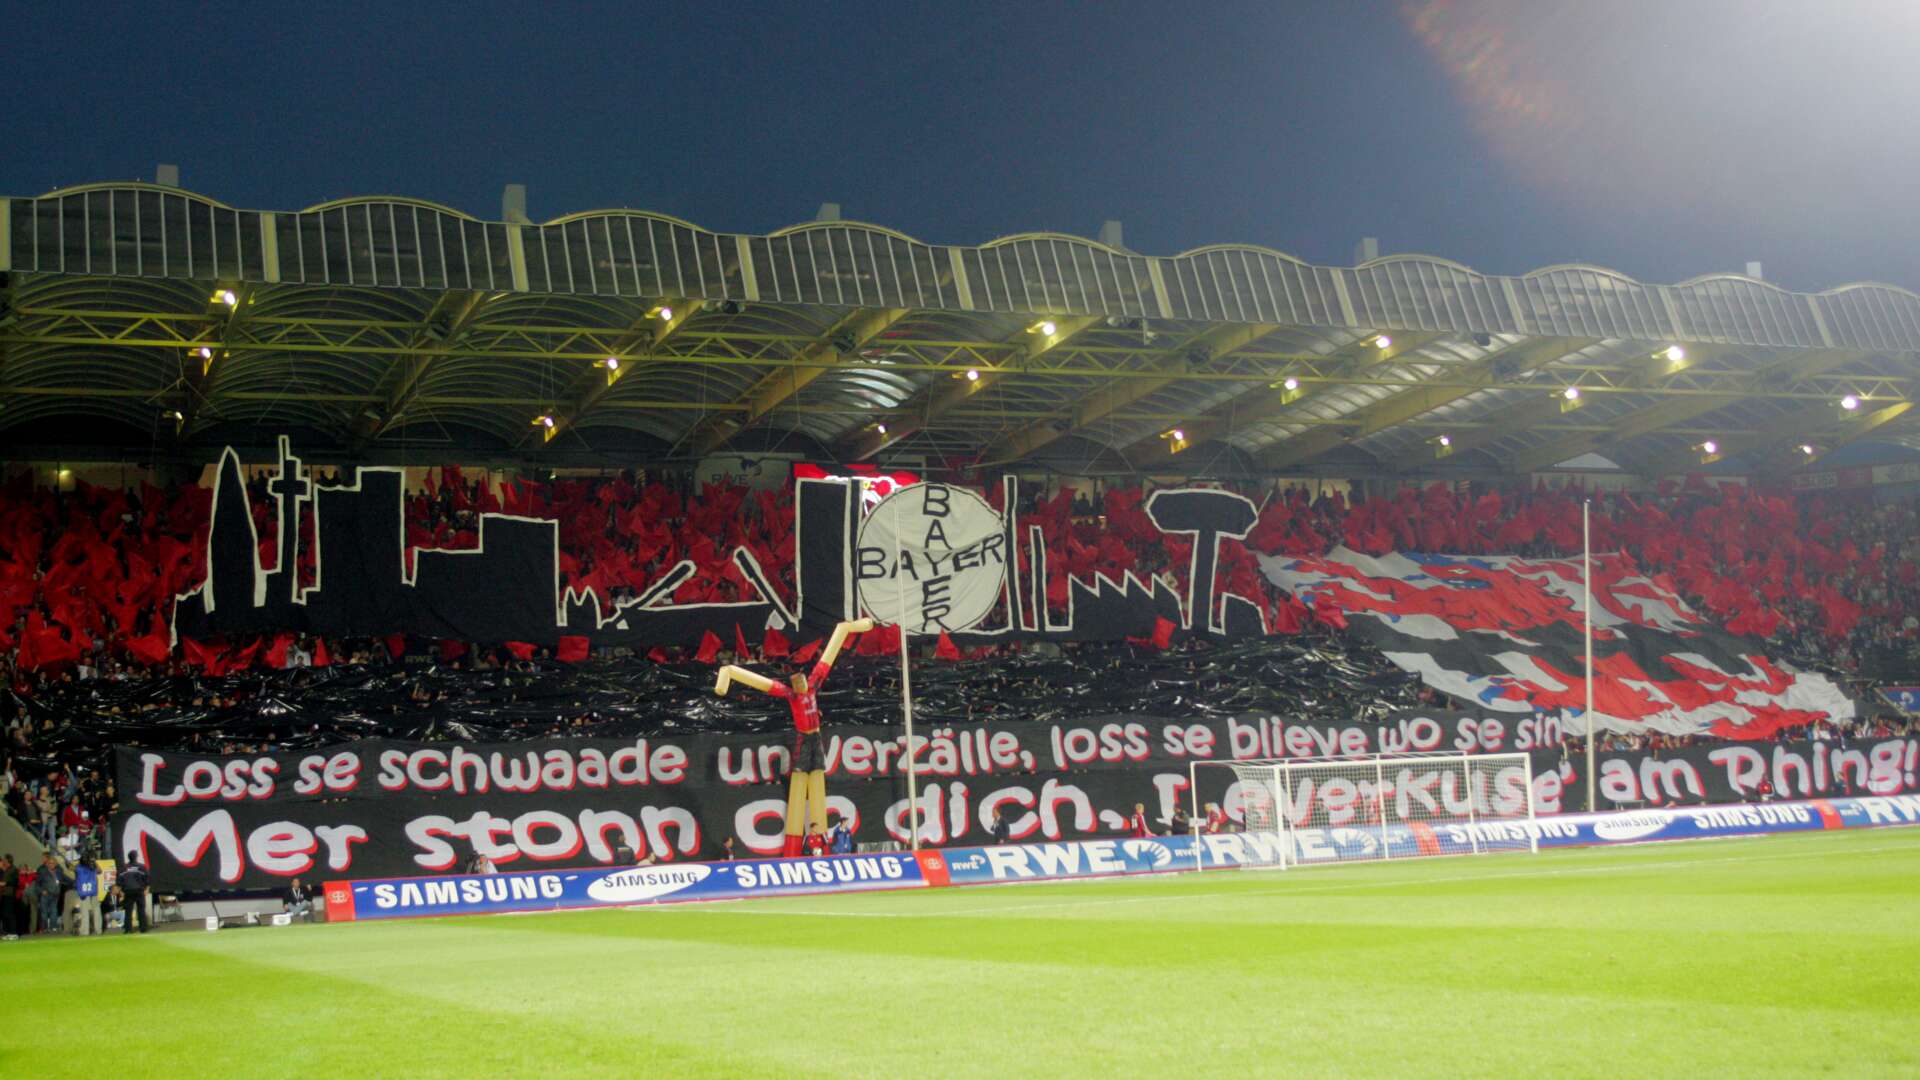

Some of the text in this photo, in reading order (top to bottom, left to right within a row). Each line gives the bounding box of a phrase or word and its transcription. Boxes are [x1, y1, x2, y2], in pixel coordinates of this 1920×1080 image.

[857, 532, 1005, 581] BAYER
[921, 484, 953, 632] BAYER
[137, 752, 279, 807] Loss
[293, 750, 362, 795] se
[378, 738, 688, 797] schwaade
[718, 744, 792, 785] un
[1051, 723, 1150, 772] loss
[1162, 723, 1216, 758] se
[1227, 715, 1369, 761] blieve
[1377, 716, 1443, 752] wo
[1453, 717, 1507, 752] se
[1514, 712, 1564, 750] sin
[122, 808, 367, 884] Mer
[405, 805, 699, 871] stonn
[1600, 756, 1706, 804] am
[1602, 815, 1669, 829] SAMSUNG
[1694, 804, 1811, 829] SAMSUNG
[984, 840, 1127, 879] RWE
[1202, 828, 1336, 866] RWE
[603, 869, 700, 889] SAMSUNG
[734, 855, 903, 888] SAMSUNG
[952, 860, 980, 871] RWE
[375, 874, 563, 909] SAMSUNG
